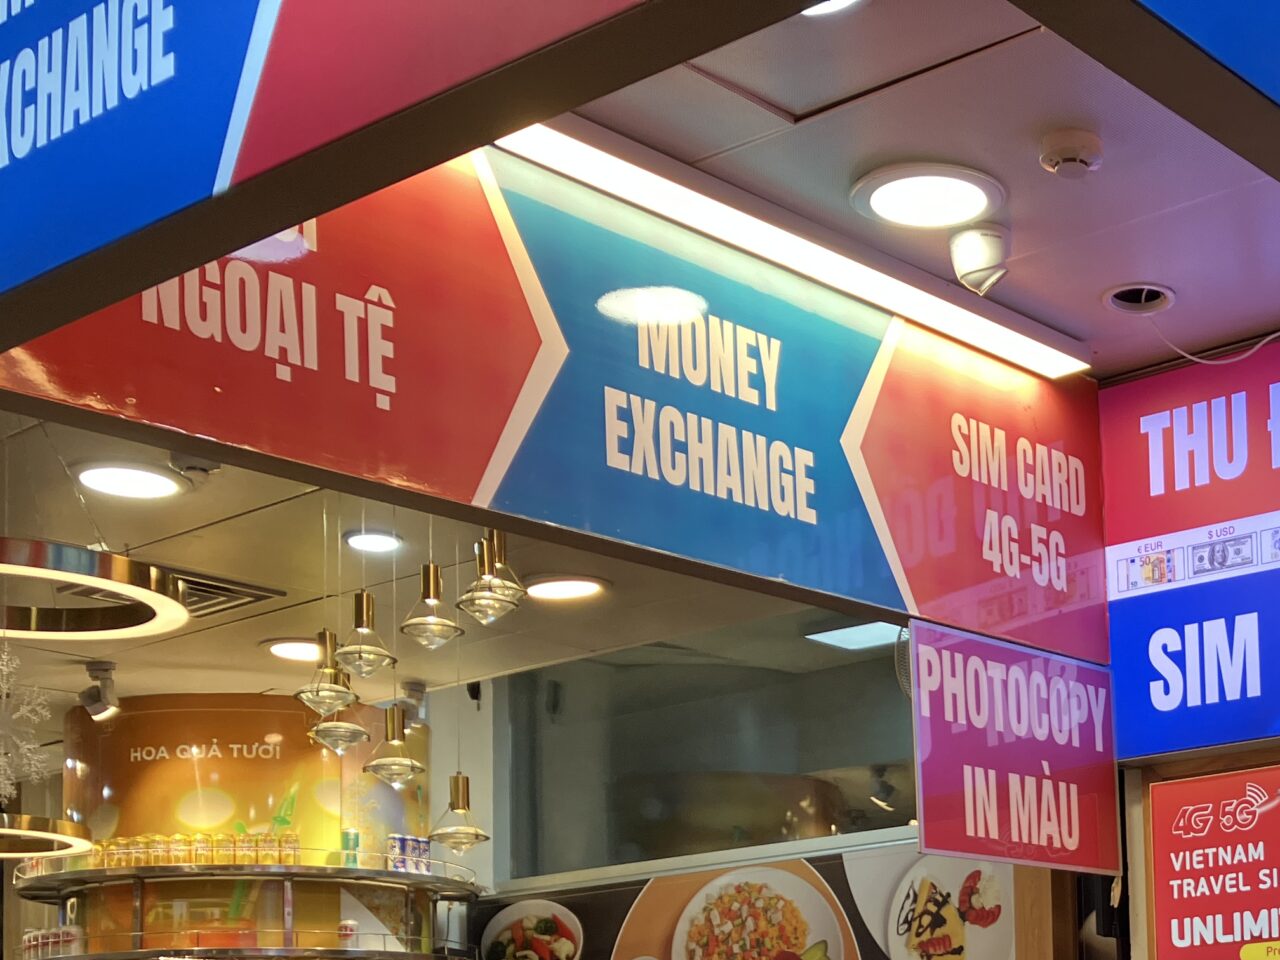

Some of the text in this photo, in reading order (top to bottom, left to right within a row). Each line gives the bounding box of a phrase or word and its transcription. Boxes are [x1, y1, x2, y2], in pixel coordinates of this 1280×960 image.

[142, 259, 396, 411] NGOẠI TỆ
[637, 308, 781, 411] MONEY
[604, 386, 818, 525] EXCHANGE
[950, 412, 1086, 517] SIM CARD
[1139, 391, 1249, 497] THU
[981, 508, 1068, 592] 4G-5G
[1144, 541, 1163, 552] EUR
[1208, 526, 1235, 540] $ USD
[918, 644, 1106, 752] PHOTOCOPY
[1147, 611, 1261, 713] SIM
[130, 738, 281, 763] HOA QUẢ TƯƠI
[963, 760, 1080, 850] IN MÀU
[1172, 797, 1258, 838] 4G 5G
[1169, 841, 1264, 871] VIETNAM
[1169, 872, 1250, 899] TRAVEL
